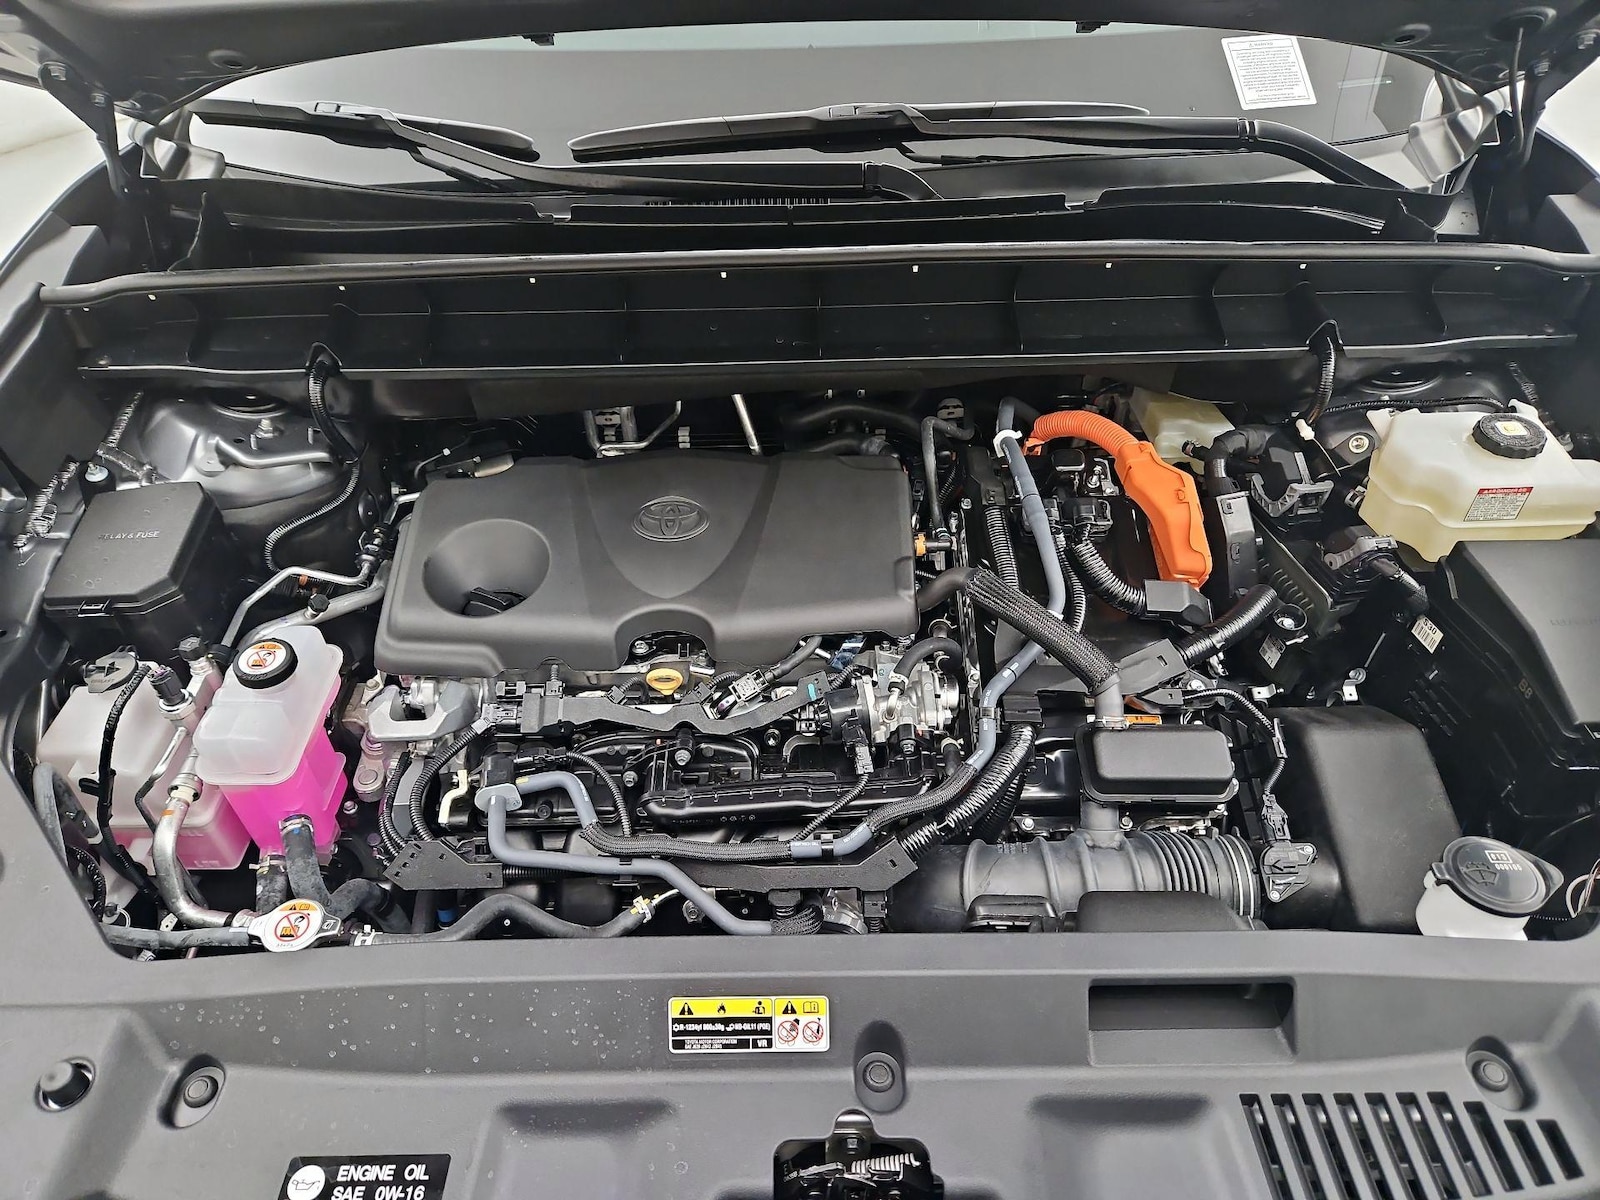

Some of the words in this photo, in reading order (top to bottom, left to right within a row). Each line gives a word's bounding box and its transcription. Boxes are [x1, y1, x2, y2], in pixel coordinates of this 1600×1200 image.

[136, 531, 160, 539] FUSE
[757, 1039, 768, 1047] VR
[336, 1164, 397, 1182] ENGINE
[404, 1164, 430, 1181] OIL
[331, 1186, 366, 1200] SAE
[374, 1185, 426, 1200] 0W-16
